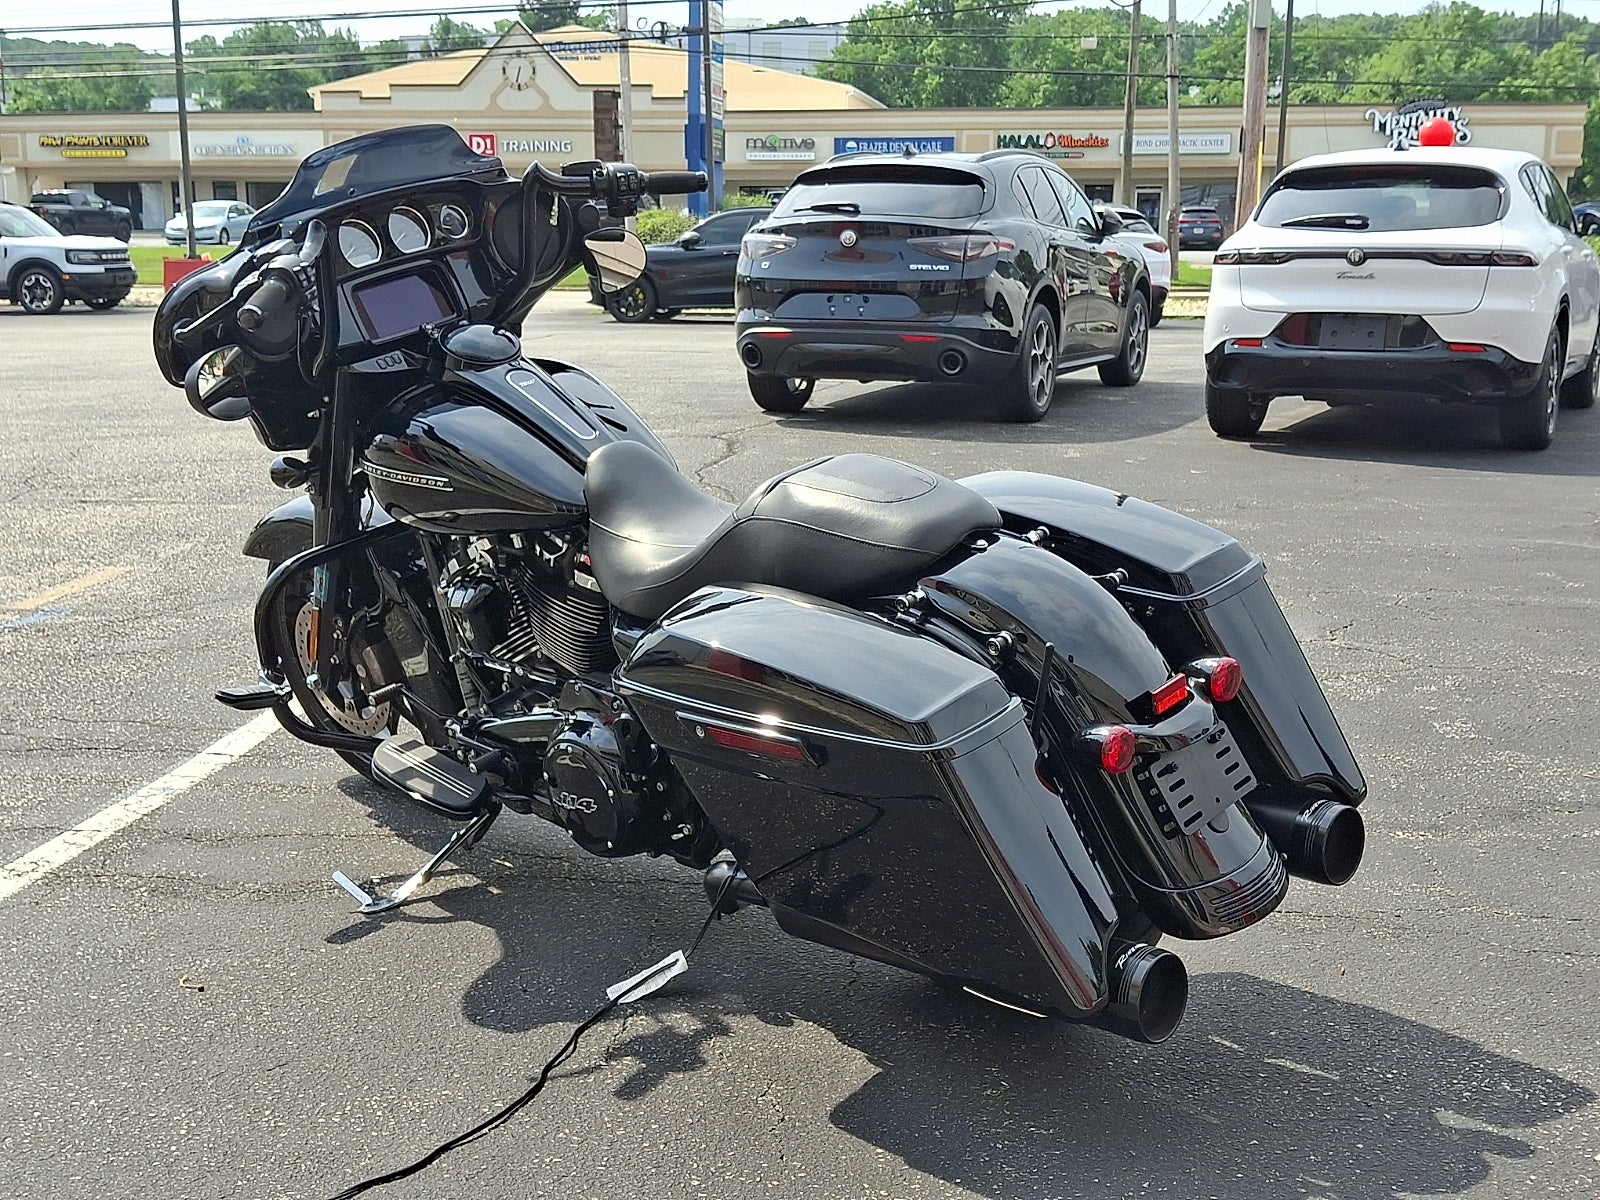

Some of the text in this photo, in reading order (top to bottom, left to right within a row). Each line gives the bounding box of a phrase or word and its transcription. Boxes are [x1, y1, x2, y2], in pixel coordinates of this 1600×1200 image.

[39, 135, 149, 146] PAW PRINTS FOREVER
[502, 140, 572, 153] TRAINING
[859, 142, 888, 152] FRAZER
[920, 142, 942, 152] CARE
[997, 133, 1109, 149] HALAL Munchies
[363, 465, 445, 487] ARLEY-DAVIDSON
[561, 791, 598, 813] 114
